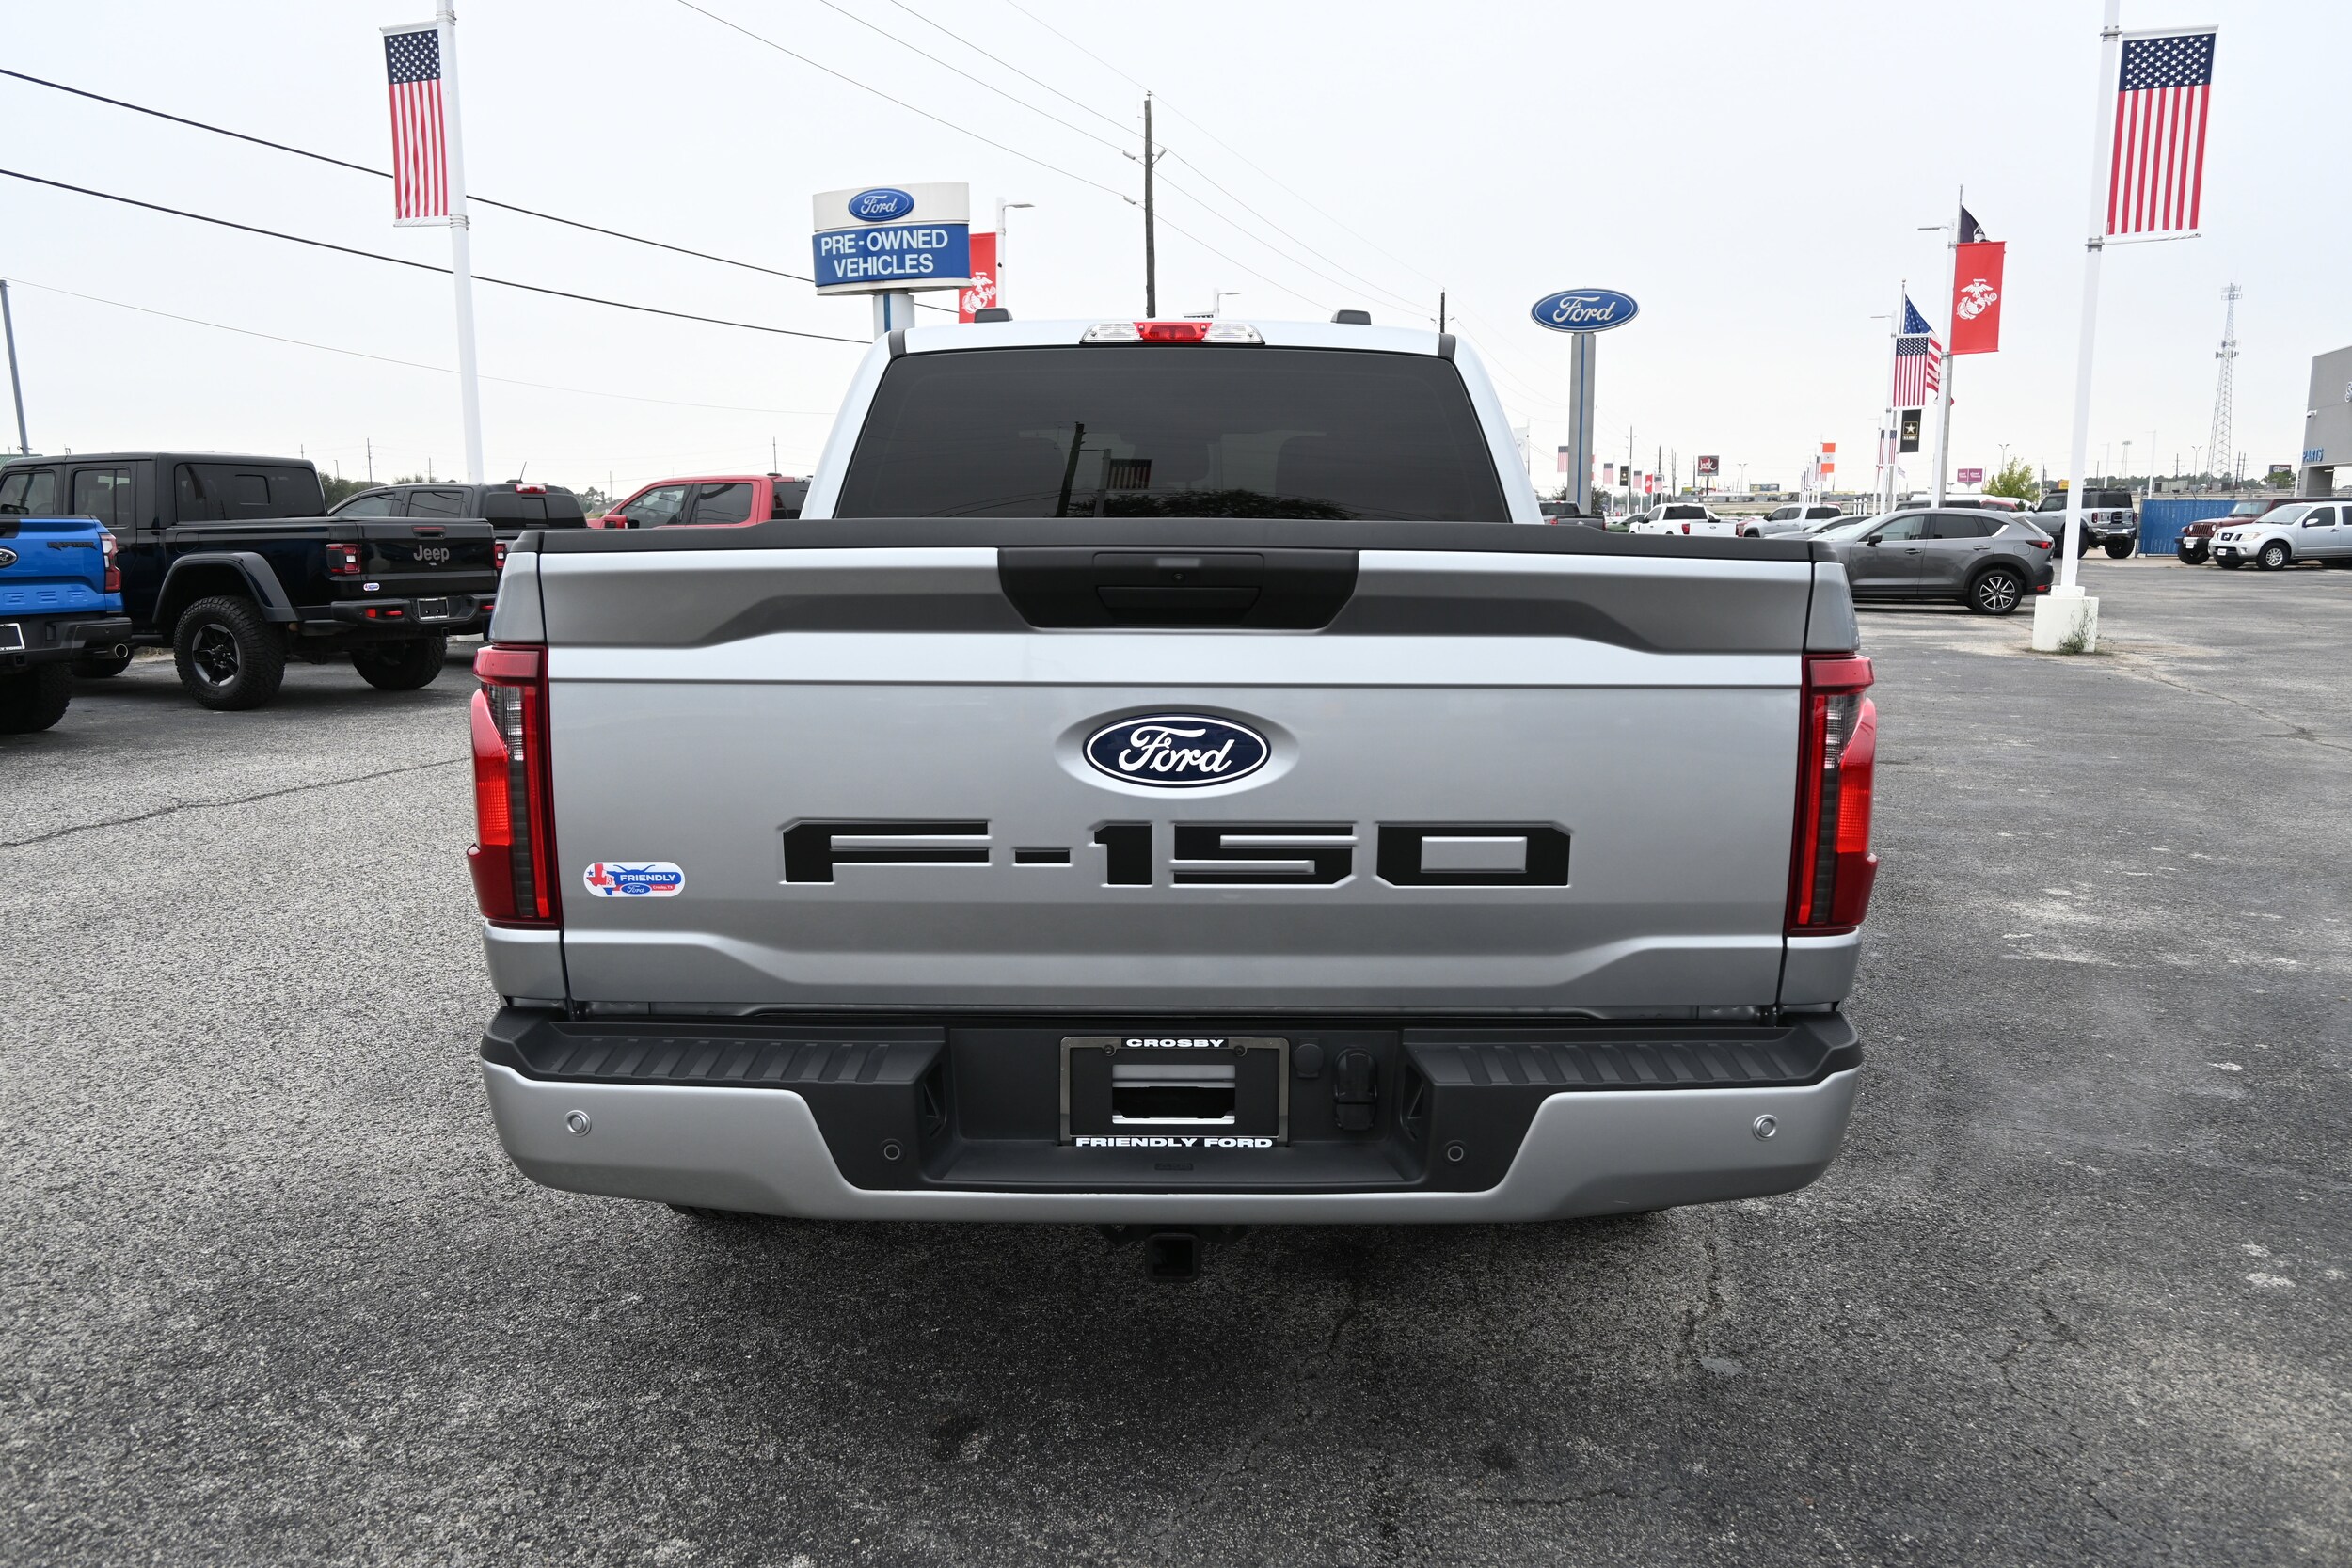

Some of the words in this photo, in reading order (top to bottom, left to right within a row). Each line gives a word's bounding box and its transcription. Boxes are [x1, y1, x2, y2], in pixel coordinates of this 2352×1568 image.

[860, 195, 898, 214] Ford
[834, 253, 934, 278] VEHICLES
[1552, 295, 1616, 323] Ford
[1698, 457, 1718, 471] Jack
[2302, 447, 2324, 463] PARTS
[413, 544, 450, 563] Jeep
[1118, 725, 1236, 773] Ford
[780, 820, 1572, 887] F-150
[626, 885, 645, 894] Ford
[1125, 1038, 1225, 1048] CROSBY
[1075, 1137, 1198, 1148] FRIENDLY
[1204, 1138, 1273, 1148] FORD
